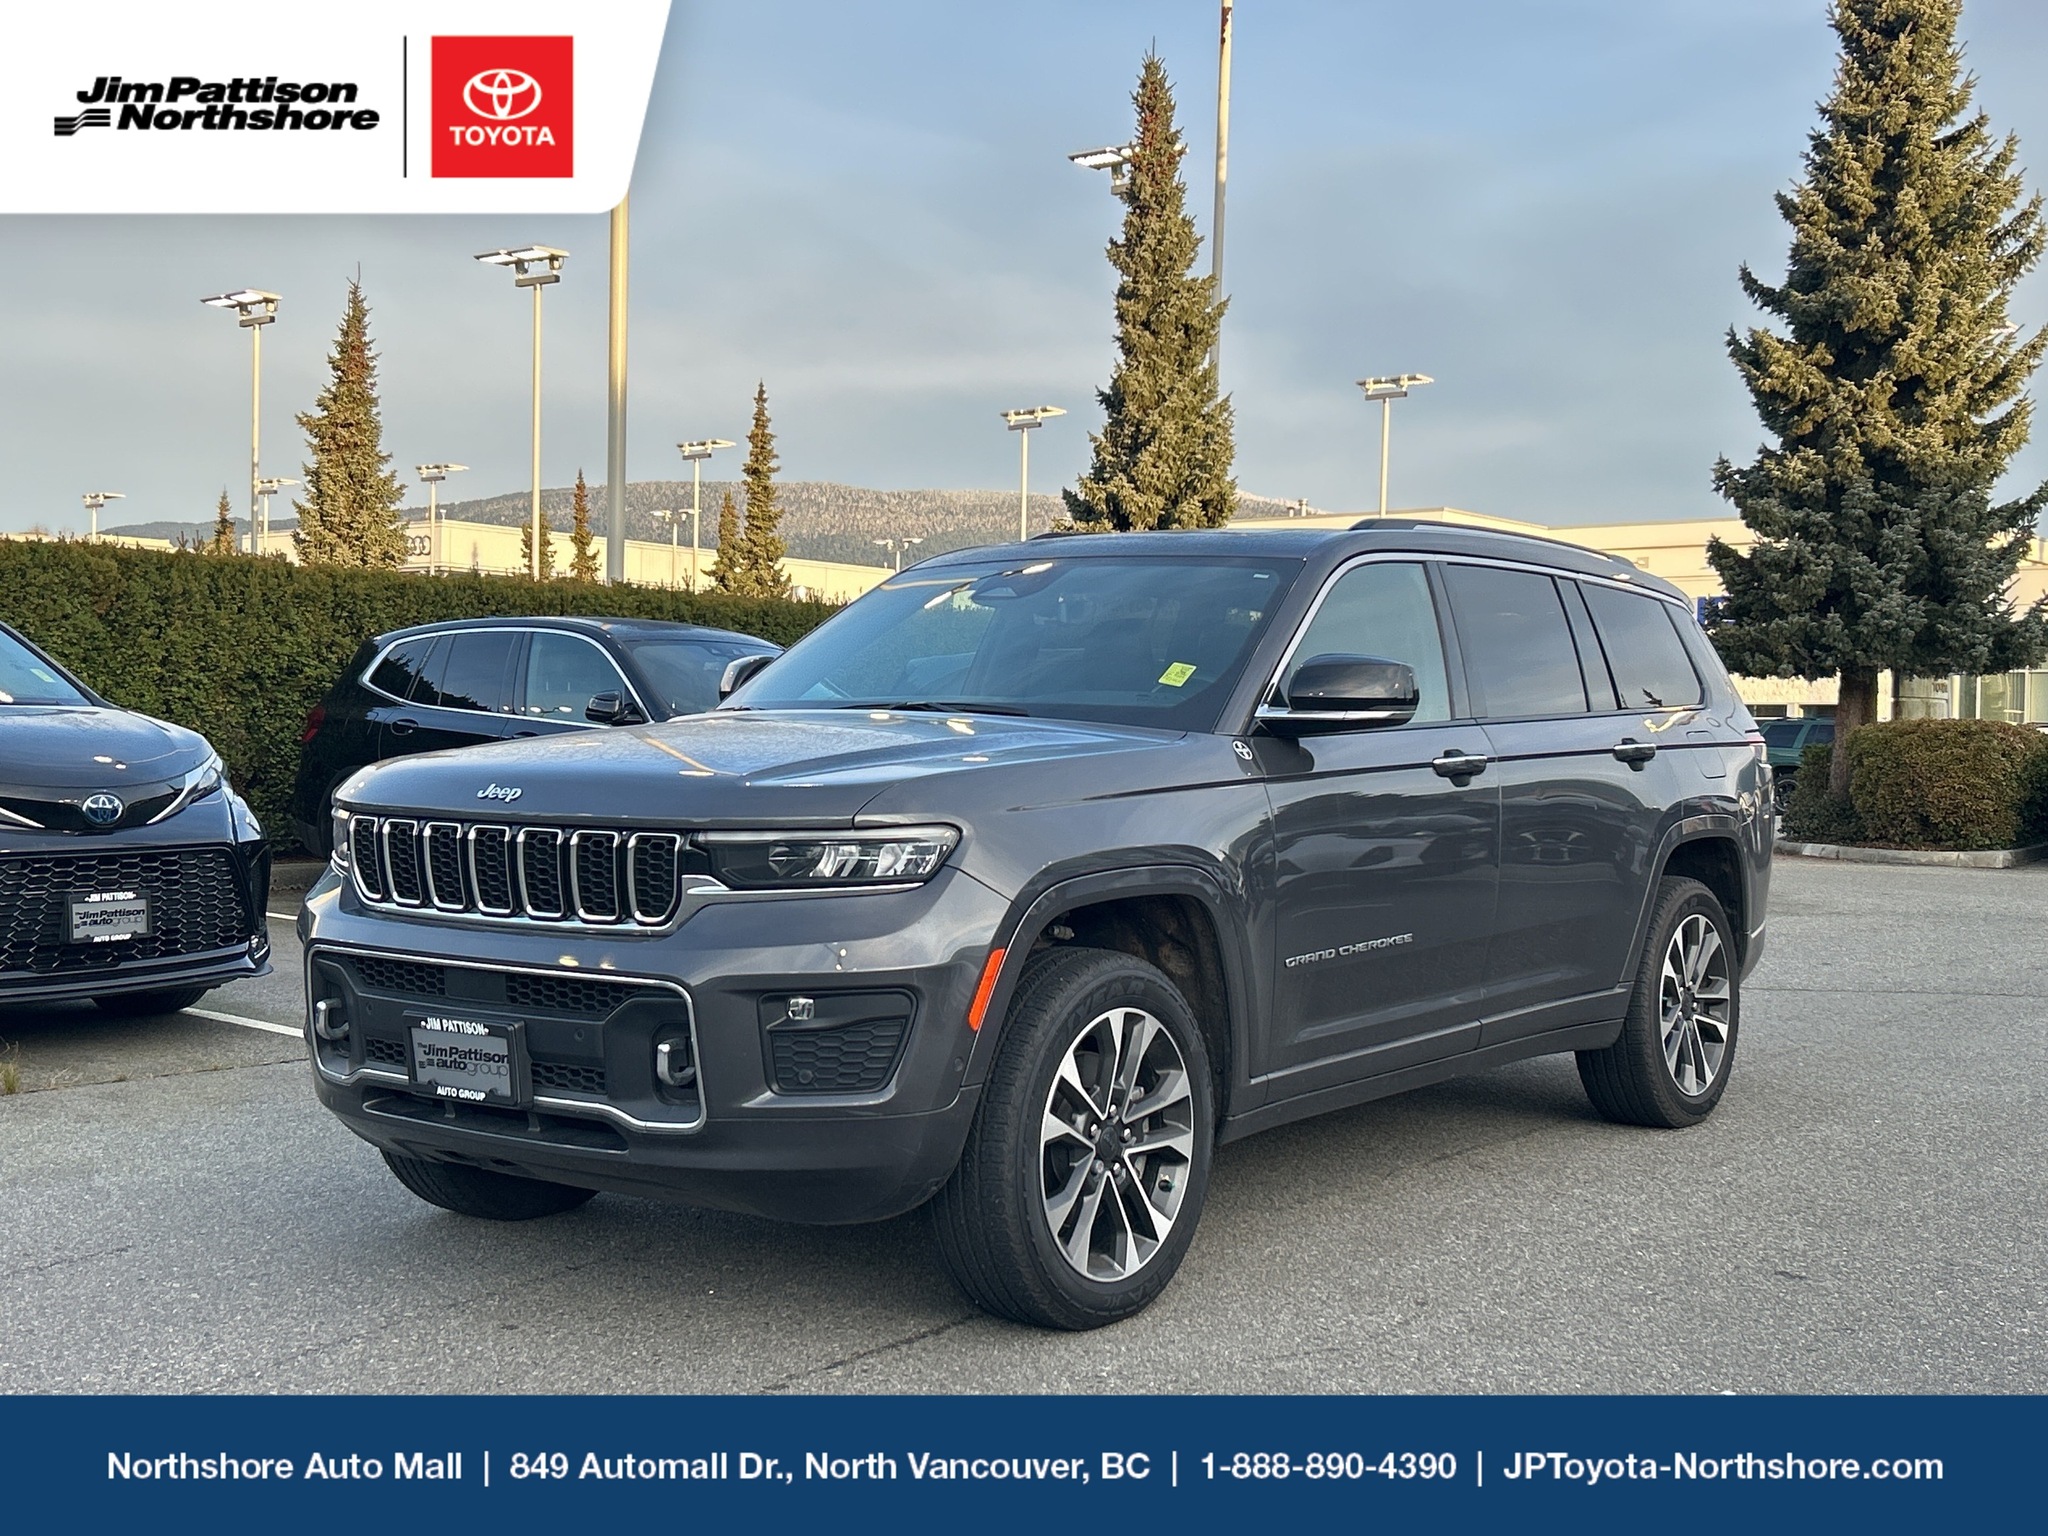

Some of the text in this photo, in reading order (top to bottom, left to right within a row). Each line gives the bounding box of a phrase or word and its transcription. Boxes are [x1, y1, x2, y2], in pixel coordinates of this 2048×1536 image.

[476, 783, 522, 803] Jeep
[88, 891, 133, 902] JIM PATTISON
[1285, 933, 1413, 968] GRAND CHEROKEE
[426, 1017, 485, 1036] JIM PATTISON
[423, 1043, 448, 1057] Jim
[437, 1086, 486, 1101] AUTO GROUP
